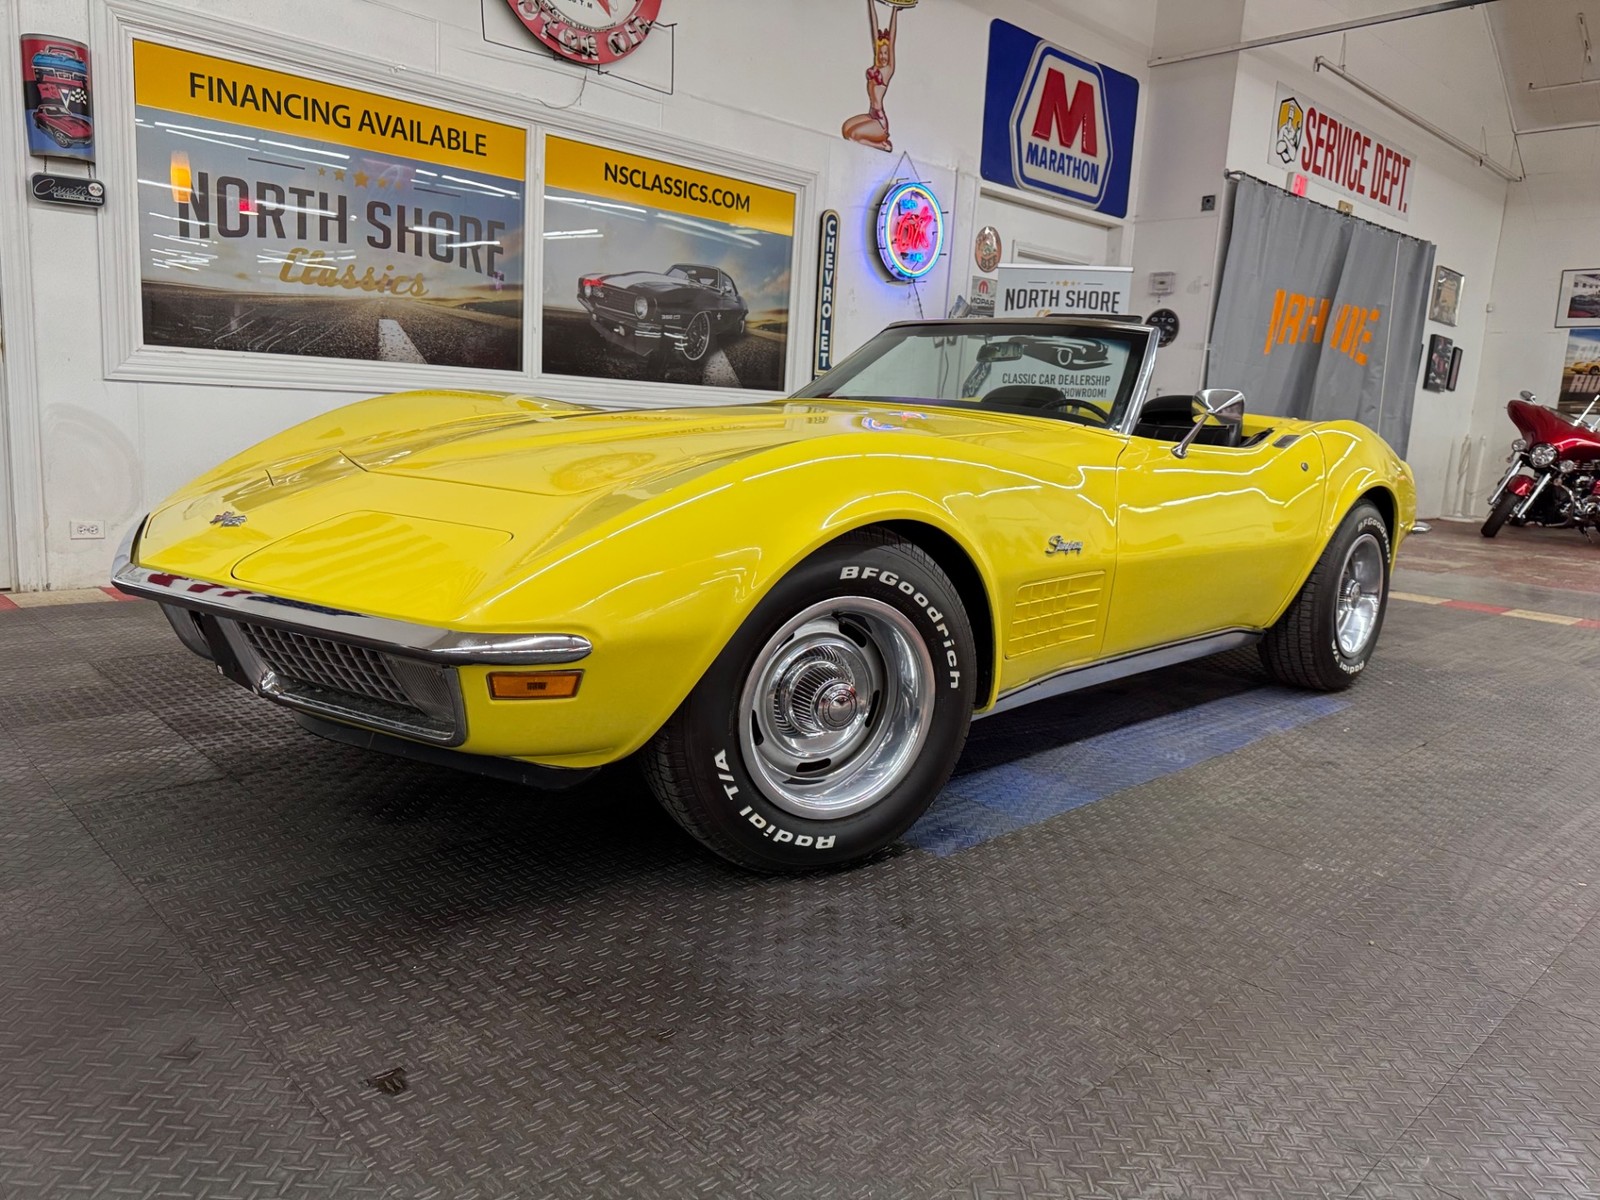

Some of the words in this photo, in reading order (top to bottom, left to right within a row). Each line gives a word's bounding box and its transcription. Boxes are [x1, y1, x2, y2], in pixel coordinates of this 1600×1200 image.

[190, 72, 351, 129] FINANCING
[358, 109, 488, 157] AVAILABLE
[1032, 67, 1098, 158] M
[1026, 142, 1100, 185] MARATHON
[1301, 107, 1372, 195] SERVICE
[1370, 143, 1412, 213] DEPT.
[34, 178, 90, 197] Corvette
[604, 162, 750, 213] NSCLASSICS.COM
[178, 171, 348, 244] NORTH
[366, 200, 505, 282] SHORE
[279, 247, 430, 297] Classics
[981, 254, 998, 270] BEE
[820, 219, 836, 368] CHEVROLET
[970, 297, 996, 306] MOPAR
[1004, 288, 1060, 312] NORTH
[1065, 290, 1121, 314] SHORE
[1151, 316, 1175, 324] GTO
[1002, 373, 1036, 385] CLASSIC
[1038, 373, 1056, 385] CAR
[1058, 374, 1111, 387] DEALERSHIP
[839, 565, 961, 690] BFGoodrich
[1339, 660, 1365, 675] Radial
[713, 749, 741, 801] T/A
[739, 805, 837, 850] Radial
